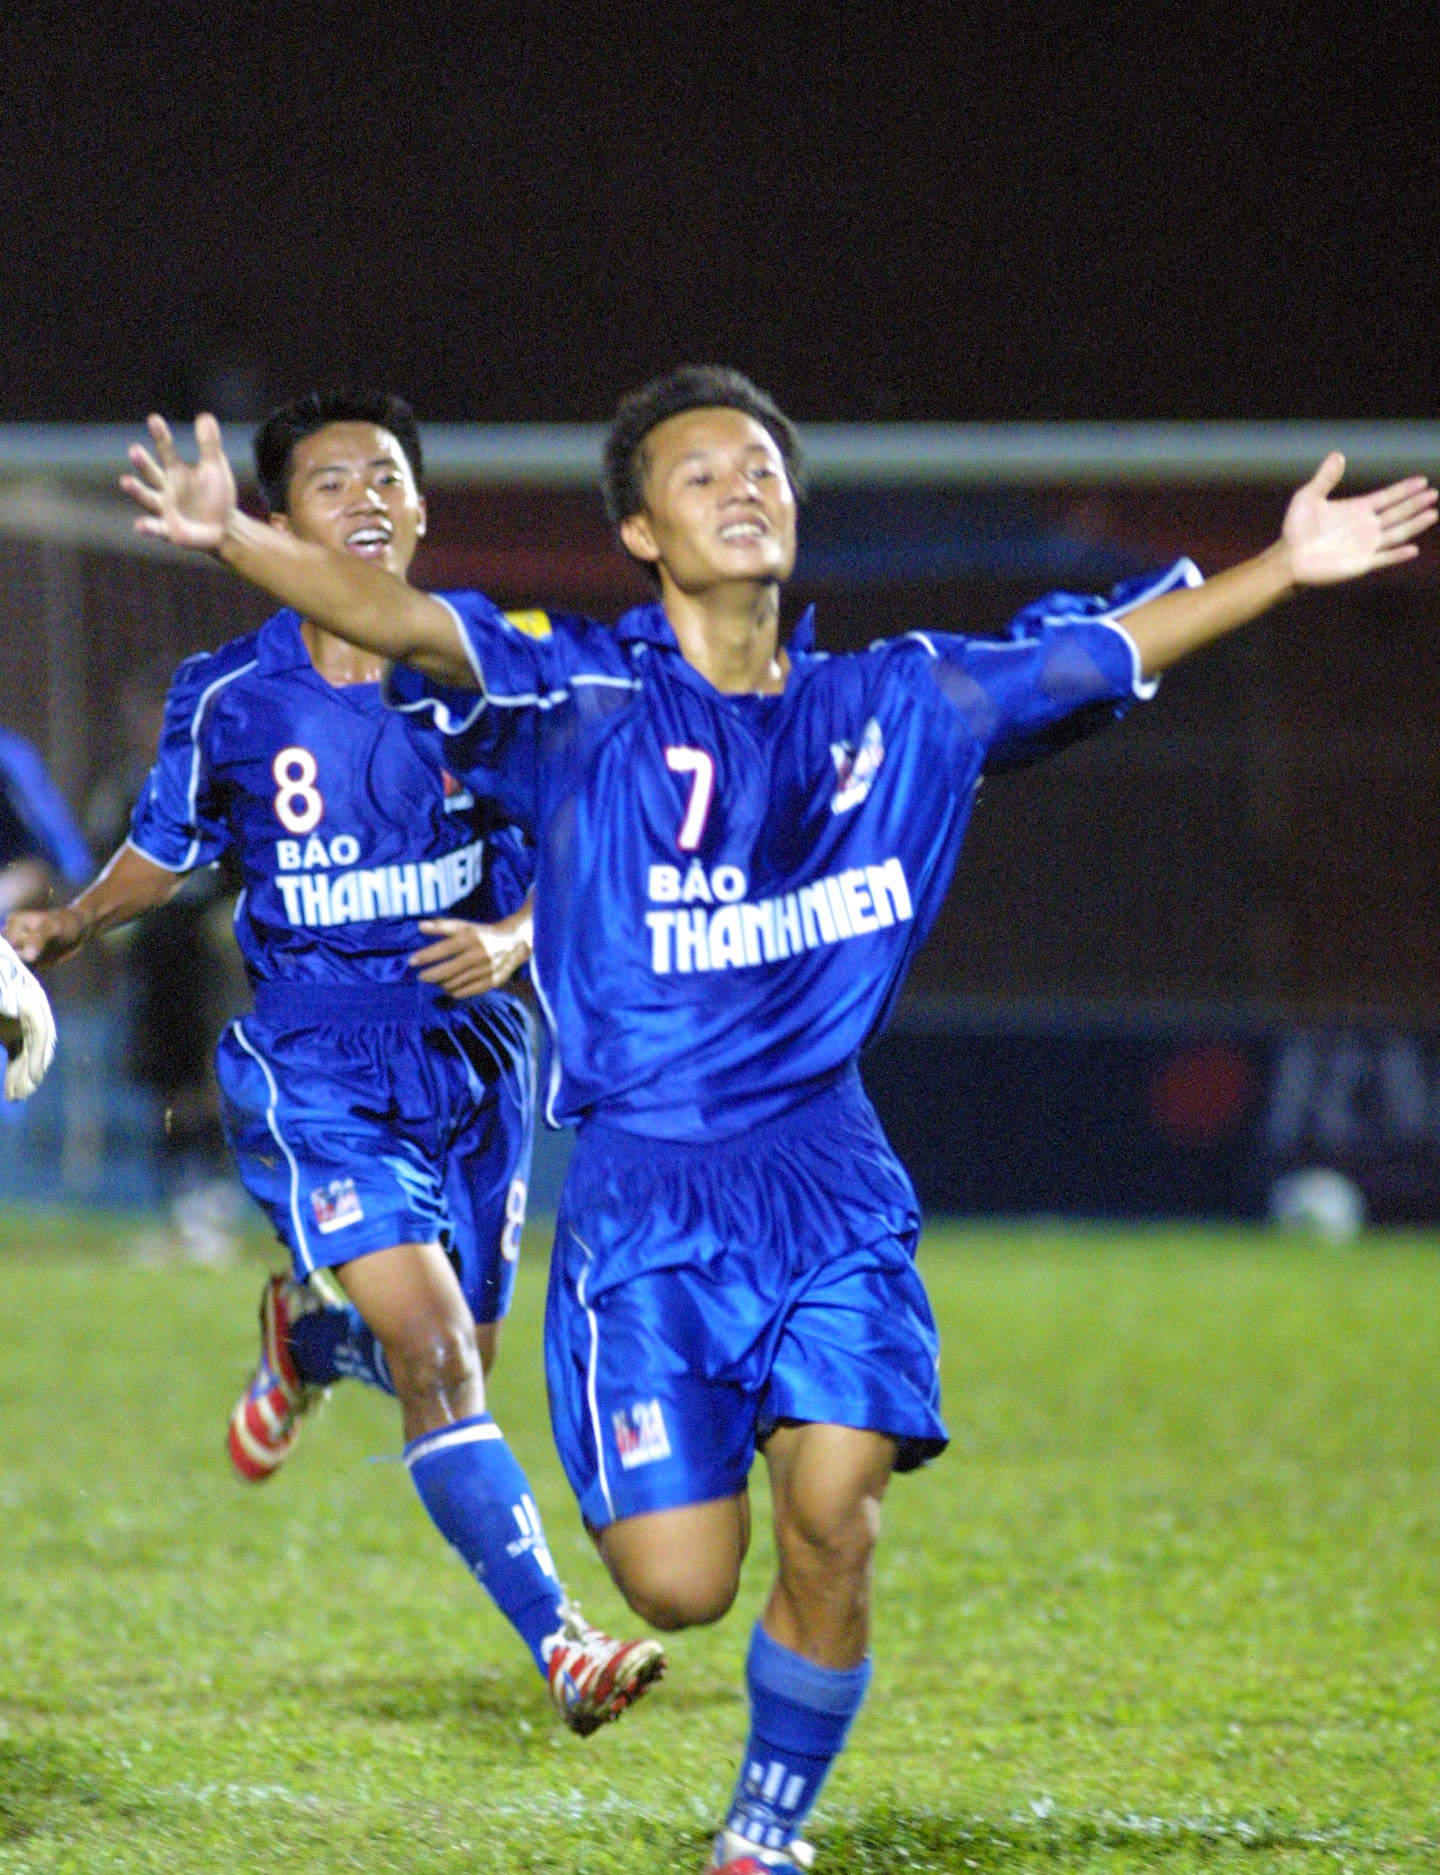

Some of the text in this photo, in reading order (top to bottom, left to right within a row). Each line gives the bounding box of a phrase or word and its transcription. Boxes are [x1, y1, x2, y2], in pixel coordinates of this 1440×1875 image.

[273, 747, 324, 834] 8
[665, 746, 714, 850] 7
[501, 1178, 527, 1262] 8
